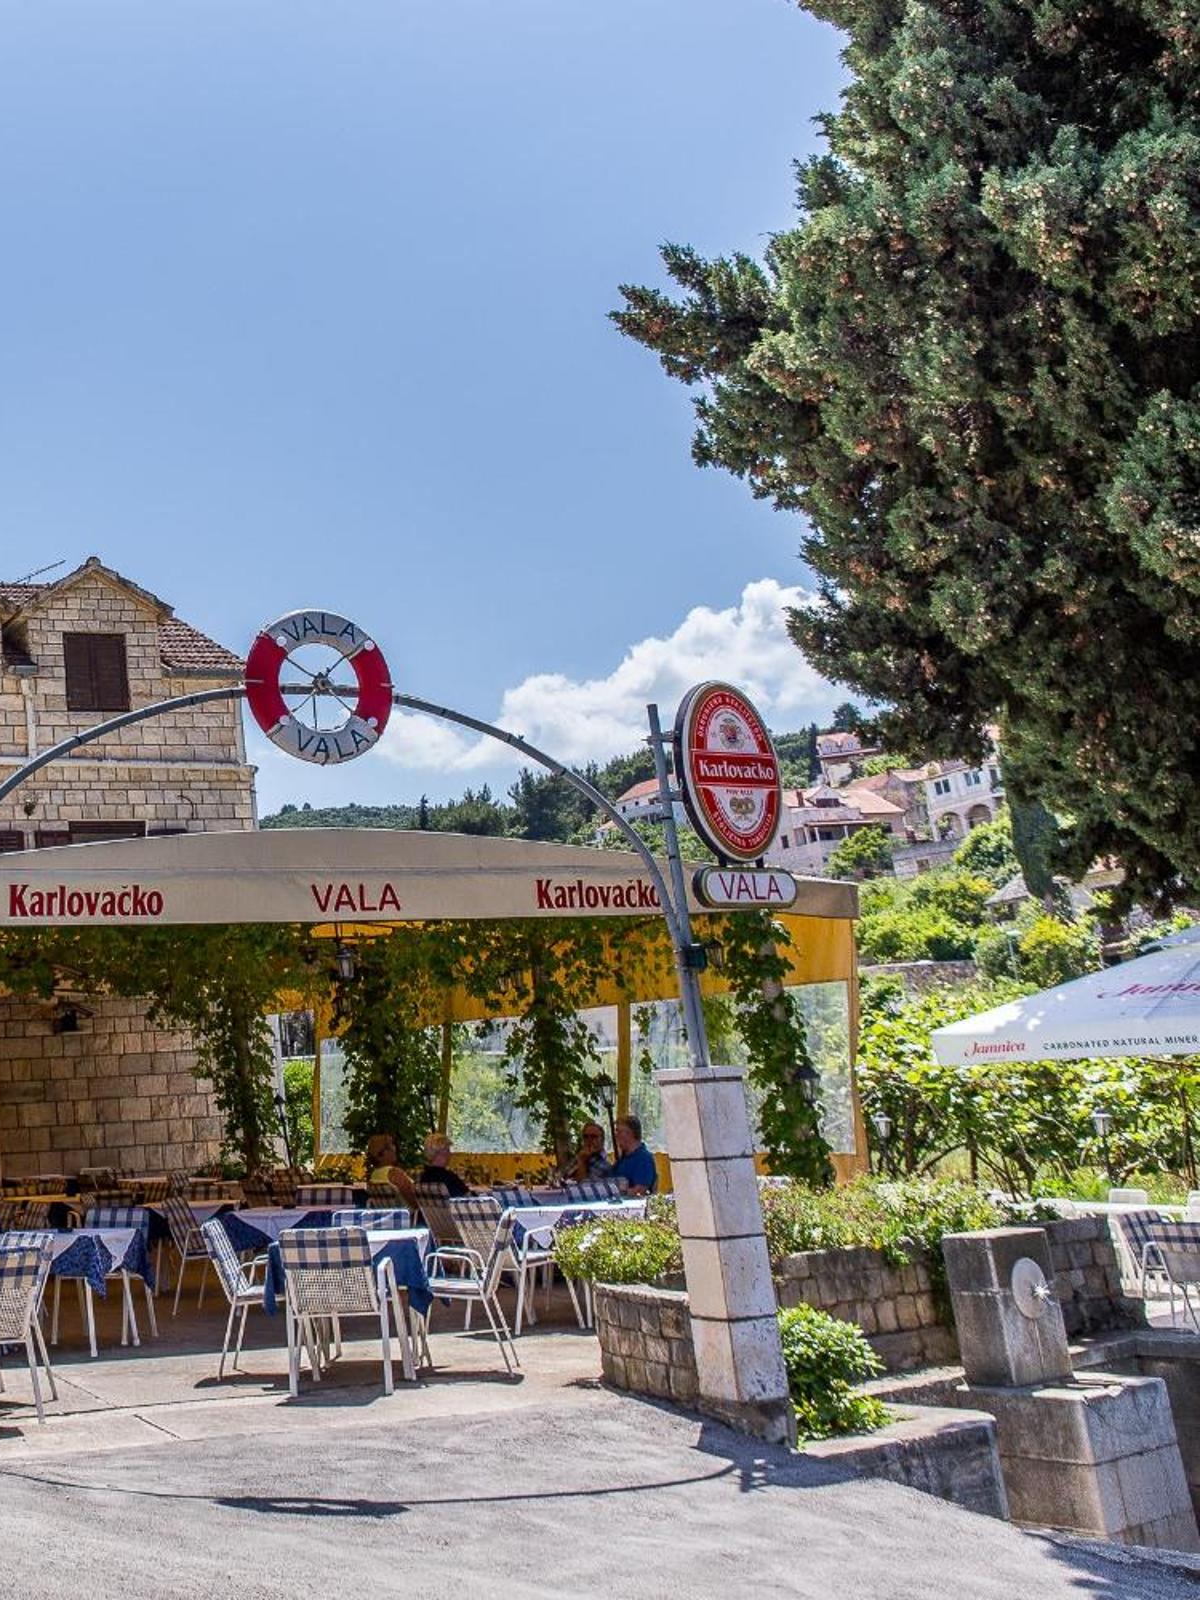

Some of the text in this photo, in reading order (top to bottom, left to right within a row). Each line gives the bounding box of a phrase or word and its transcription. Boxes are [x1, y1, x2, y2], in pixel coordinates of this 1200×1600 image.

[282, 613, 357, 644] VALA
[297, 728, 370, 759] VALA
[699, 760, 775, 780] Karlovačko
[7, 884, 164, 917] Karlovačko
[311, 883, 401, 912] VALA
[718, 873, 784, 901] VALA
[1042, 1039, 1110, 1051] CARBONATED
[1113, 1036, 1161, 1046] NATURAL
